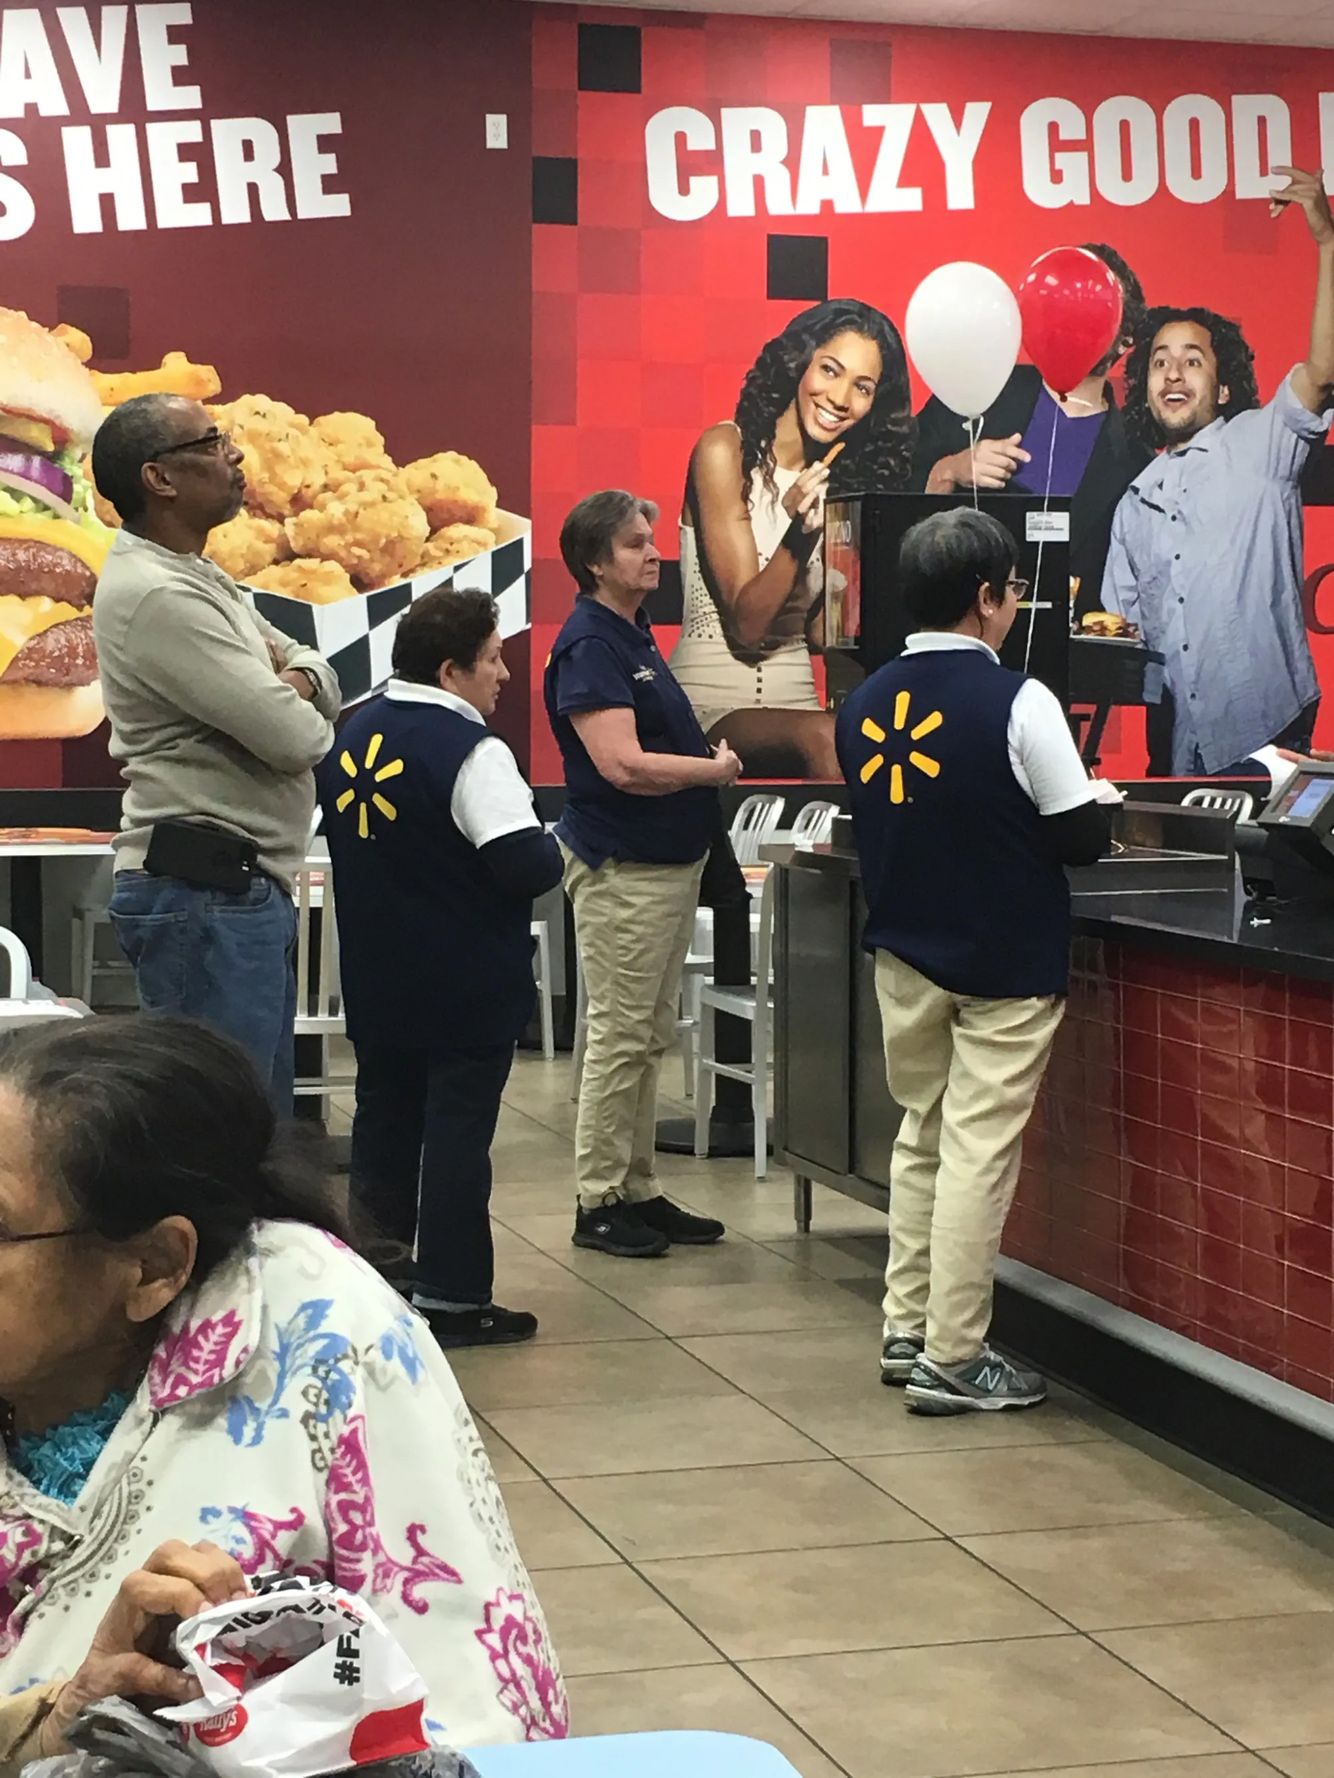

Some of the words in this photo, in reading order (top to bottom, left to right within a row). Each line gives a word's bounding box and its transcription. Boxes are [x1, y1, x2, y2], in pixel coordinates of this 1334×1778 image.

[0, 3, 203, 120] AVE
[60, 111, 352, 235] HERE
[645, 103, 993, 222] CRAZY
[1020, 94, 1292, 210] GOOD
